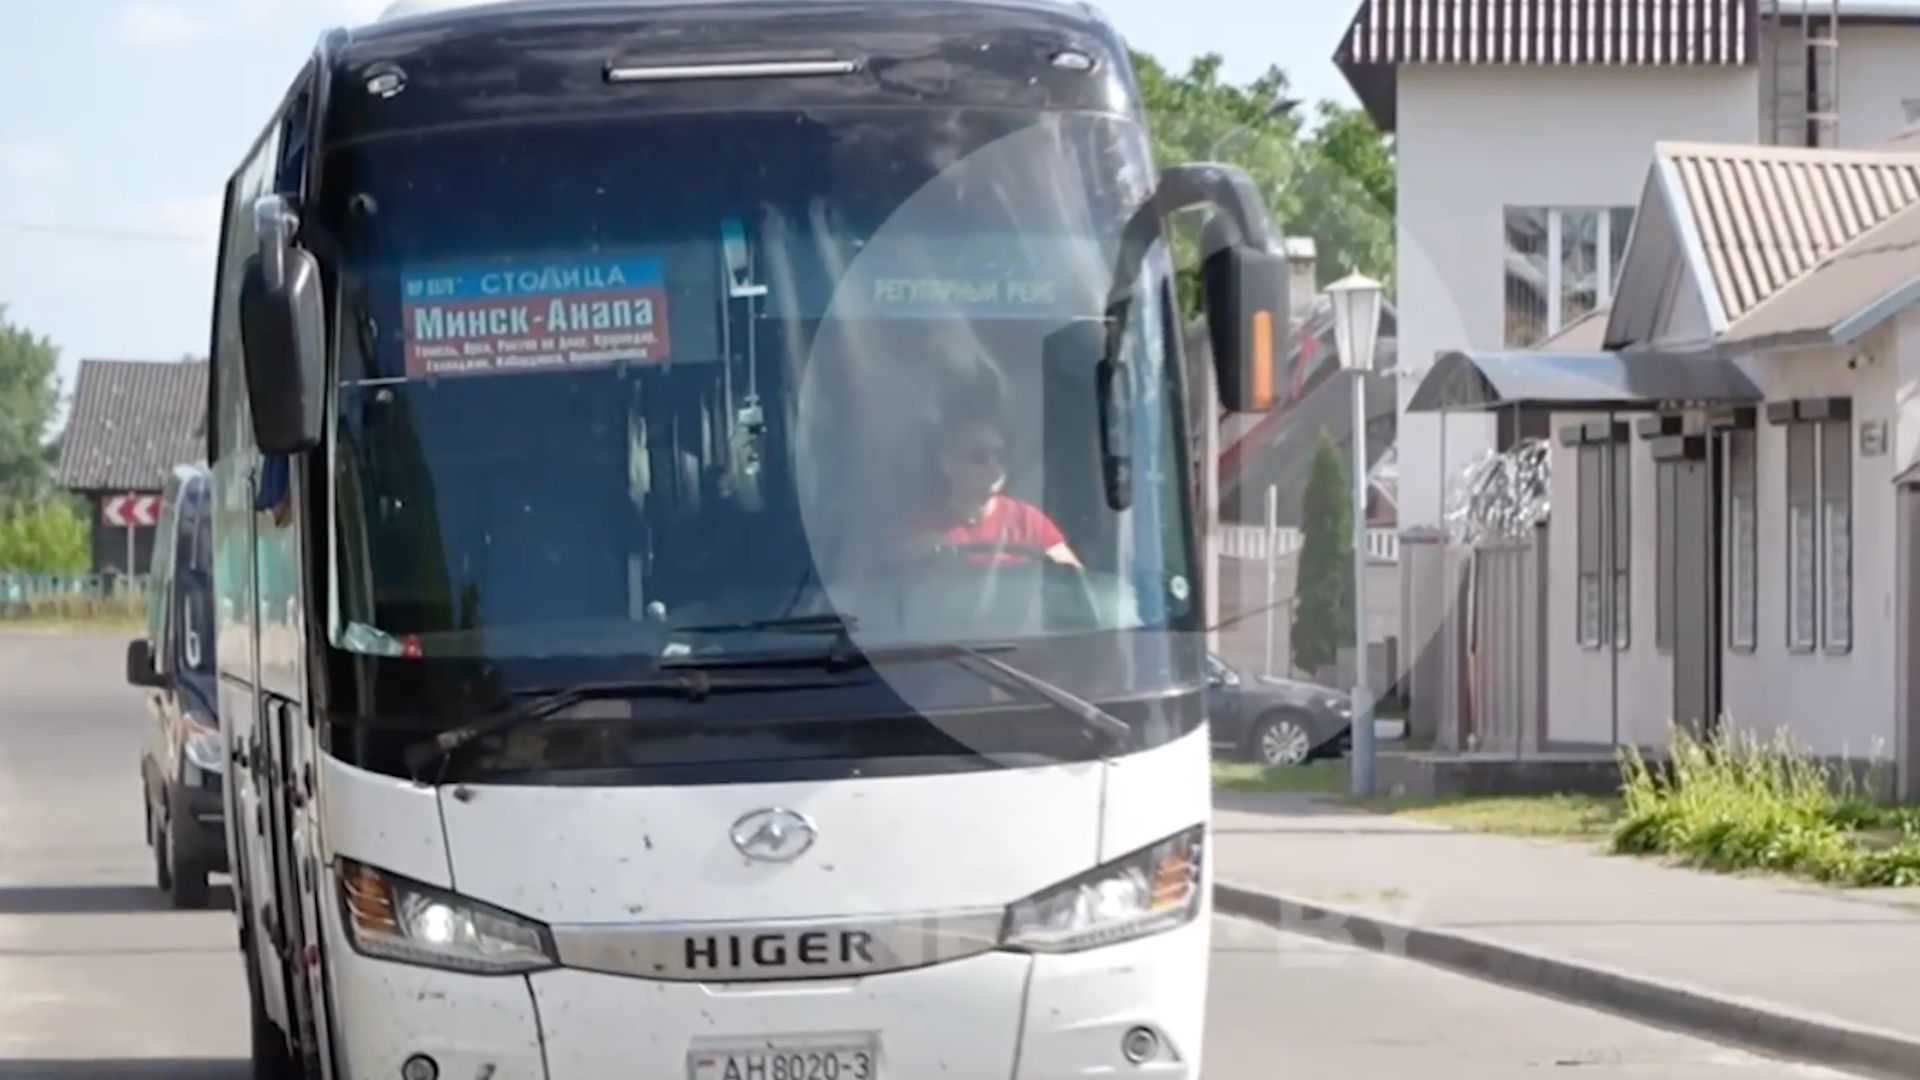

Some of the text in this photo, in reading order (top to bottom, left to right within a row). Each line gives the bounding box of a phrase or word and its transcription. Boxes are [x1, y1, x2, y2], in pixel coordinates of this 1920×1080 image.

[481, 265, 626, 295] СТОЛИЦА
[414, 298, 653, 340] Минск-Анапа
[684, 930, 874, 969] HIGER
